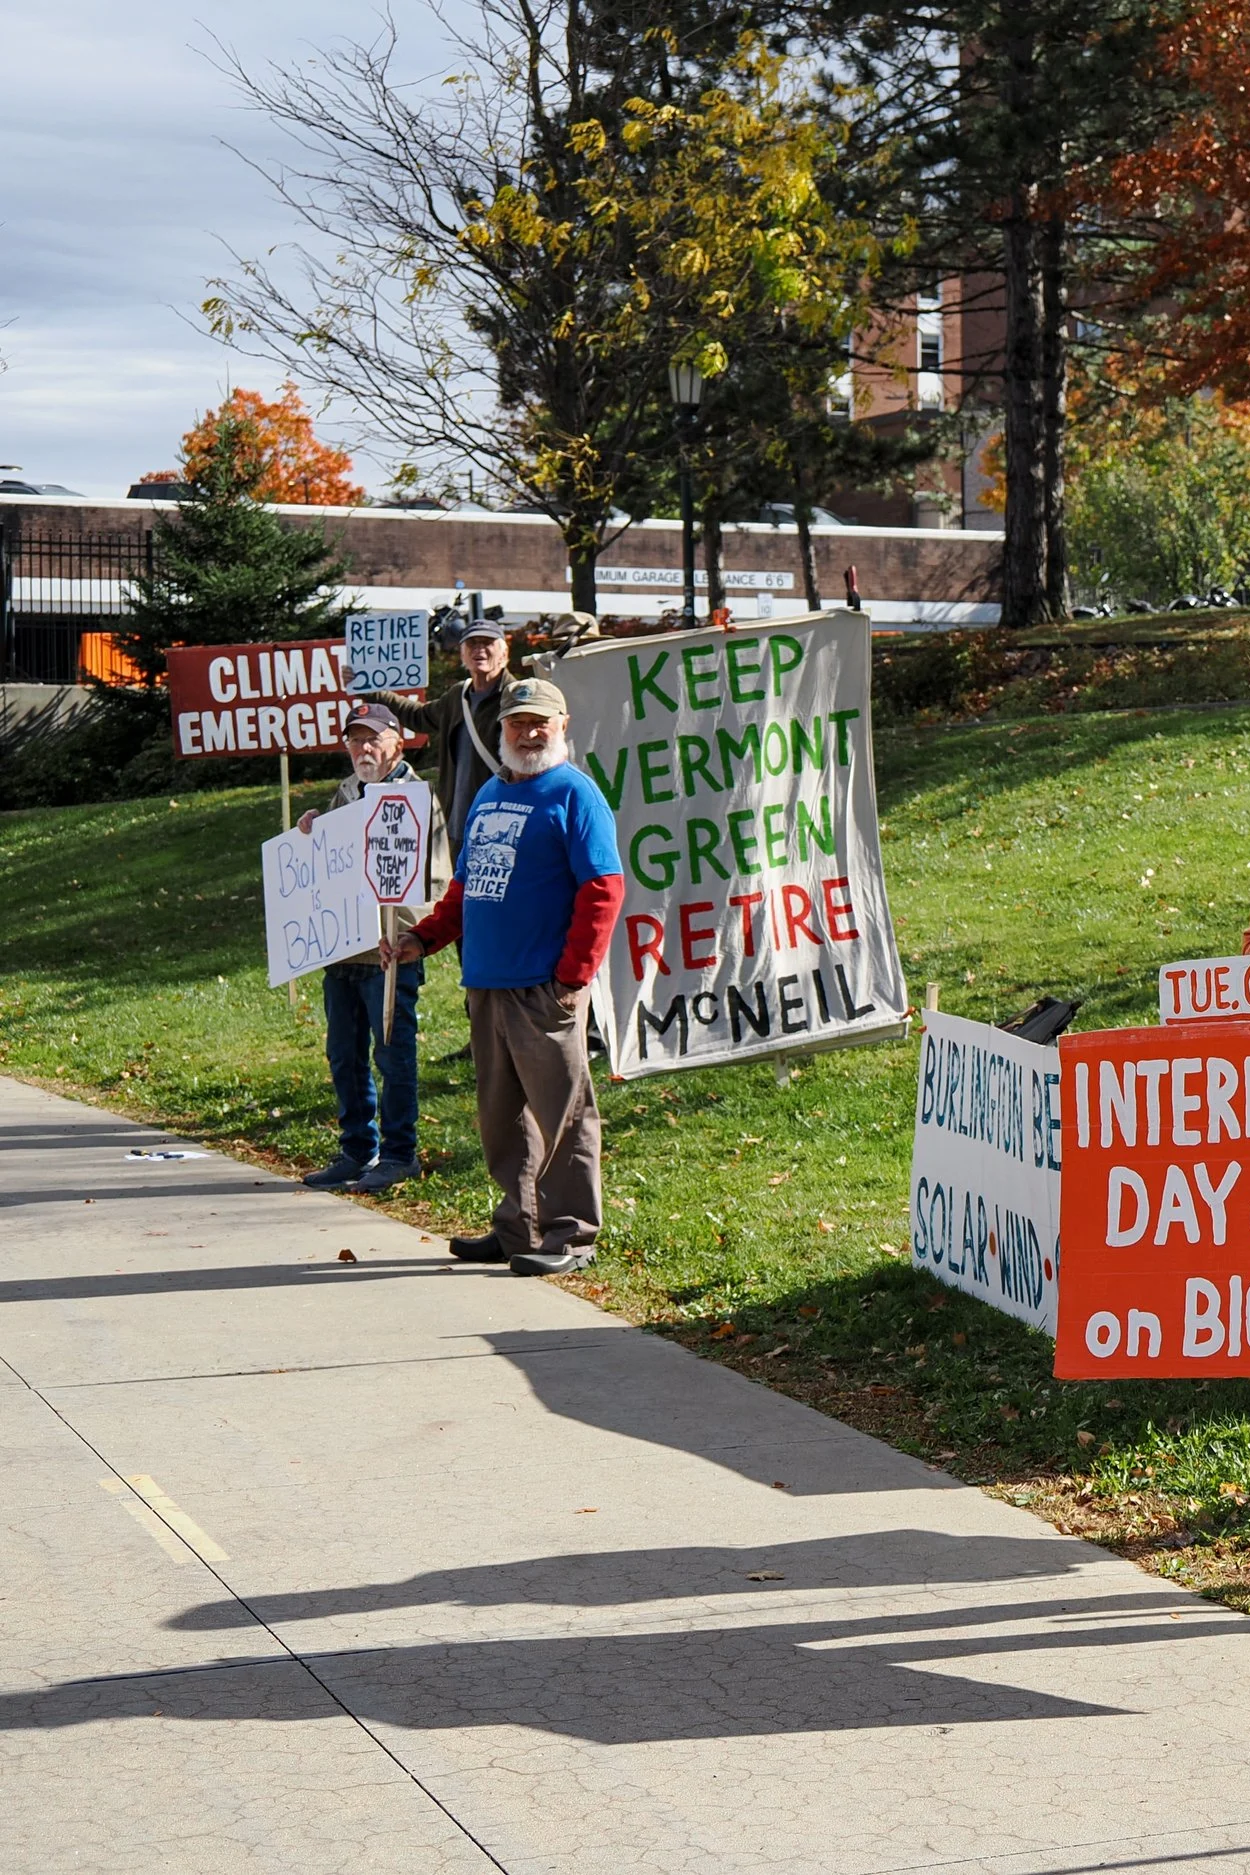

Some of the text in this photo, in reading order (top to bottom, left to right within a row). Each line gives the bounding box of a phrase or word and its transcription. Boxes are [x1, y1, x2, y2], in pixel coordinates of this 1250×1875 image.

[595, 570, 627, 582] IMUM
[632, 571, 680, 584] GARAGE
[695, 572, 756, 585] LEANCE
[351, 615, 421, 641] RETIRE
[351, 642, 423, 664] McNEIL
[208, 647, 347, 704] CLIMAT
[352, 663, 421, 690] 2028
[626, 634, 804, 721] KEEP
[178, 696, 418, 755] EMERGEN
[586, 708, 860, 812] VERMONT
[382, 801, 406, 823] STOP
[278, 828, 354, 898] BioMass
[376, 853, 408, 877] STEAM
[629, 795, 836, 891] GREEN
[310, 889, 322, 912] is
[380, 876, 402, 897] PIPE
[467, 878, 507, 895] STICE
[283, 896, 362, 970] BAD!!
[625, 876, 860, 982] RETIRE
[638, 963, 876, 1060] McNEIL
[1165, 966, 1239, 1014] TUE.
[921, 1034, 1024, 1162] BURLINGTON
[1106, 1160, 1242, 1247] DAY
[914, 1177, 989, 1287] SOLAR
[995, 1204, 1042, 1310] WIND
[1085, 1308, 1162, 1358] on
